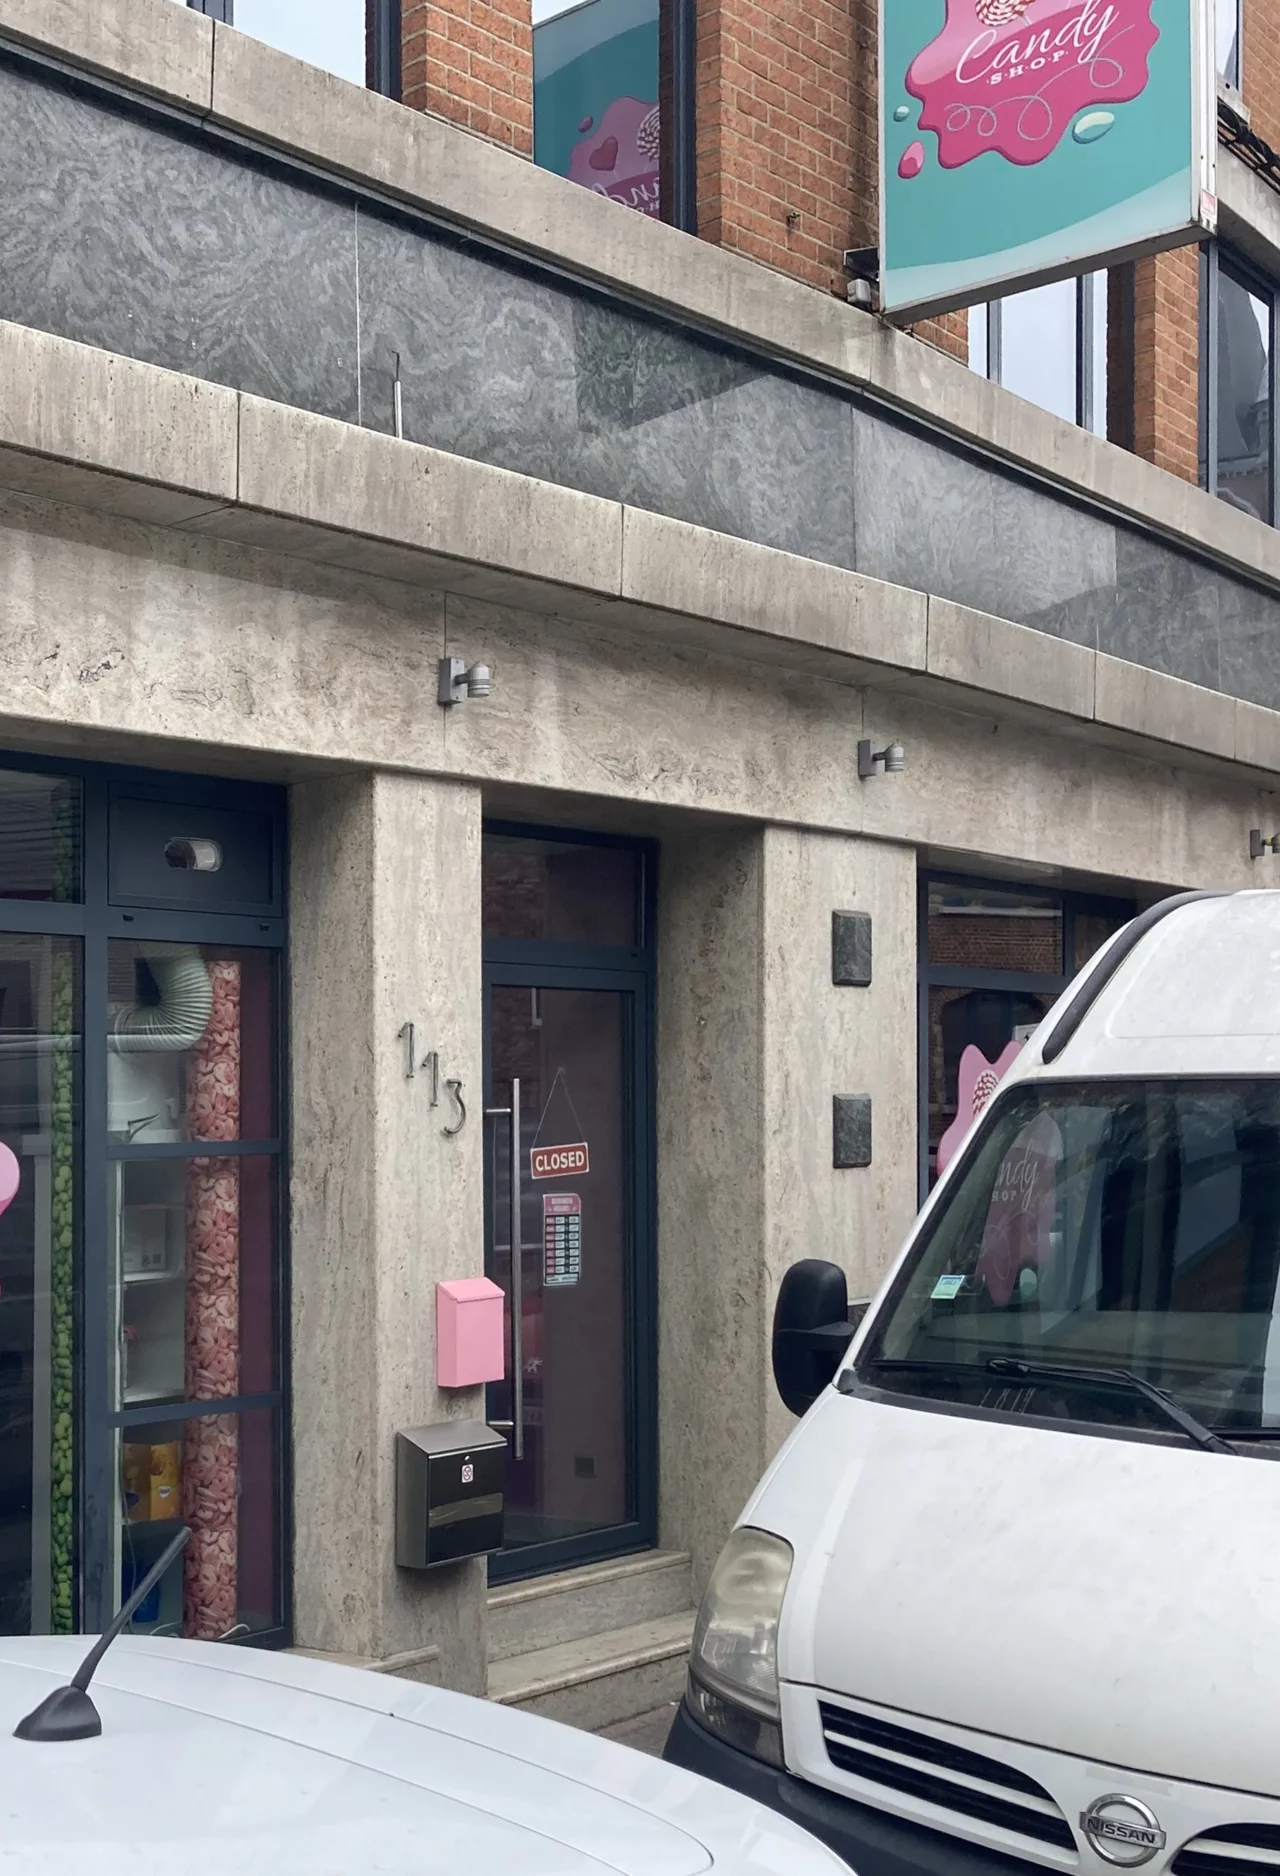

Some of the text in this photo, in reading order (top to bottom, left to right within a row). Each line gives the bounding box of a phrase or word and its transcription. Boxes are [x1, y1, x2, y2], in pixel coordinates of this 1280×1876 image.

[956, 0, 1119, 84] Candy
[398, 1021, 466, 1134] 113
[535, 1150, 585, 1172] CLOSED
[995, 1139, 1038, 1212] ndy
[991, 1190, 1017, 1202] HOP
[1087, 1818, 1156, 1844] NISSAN
